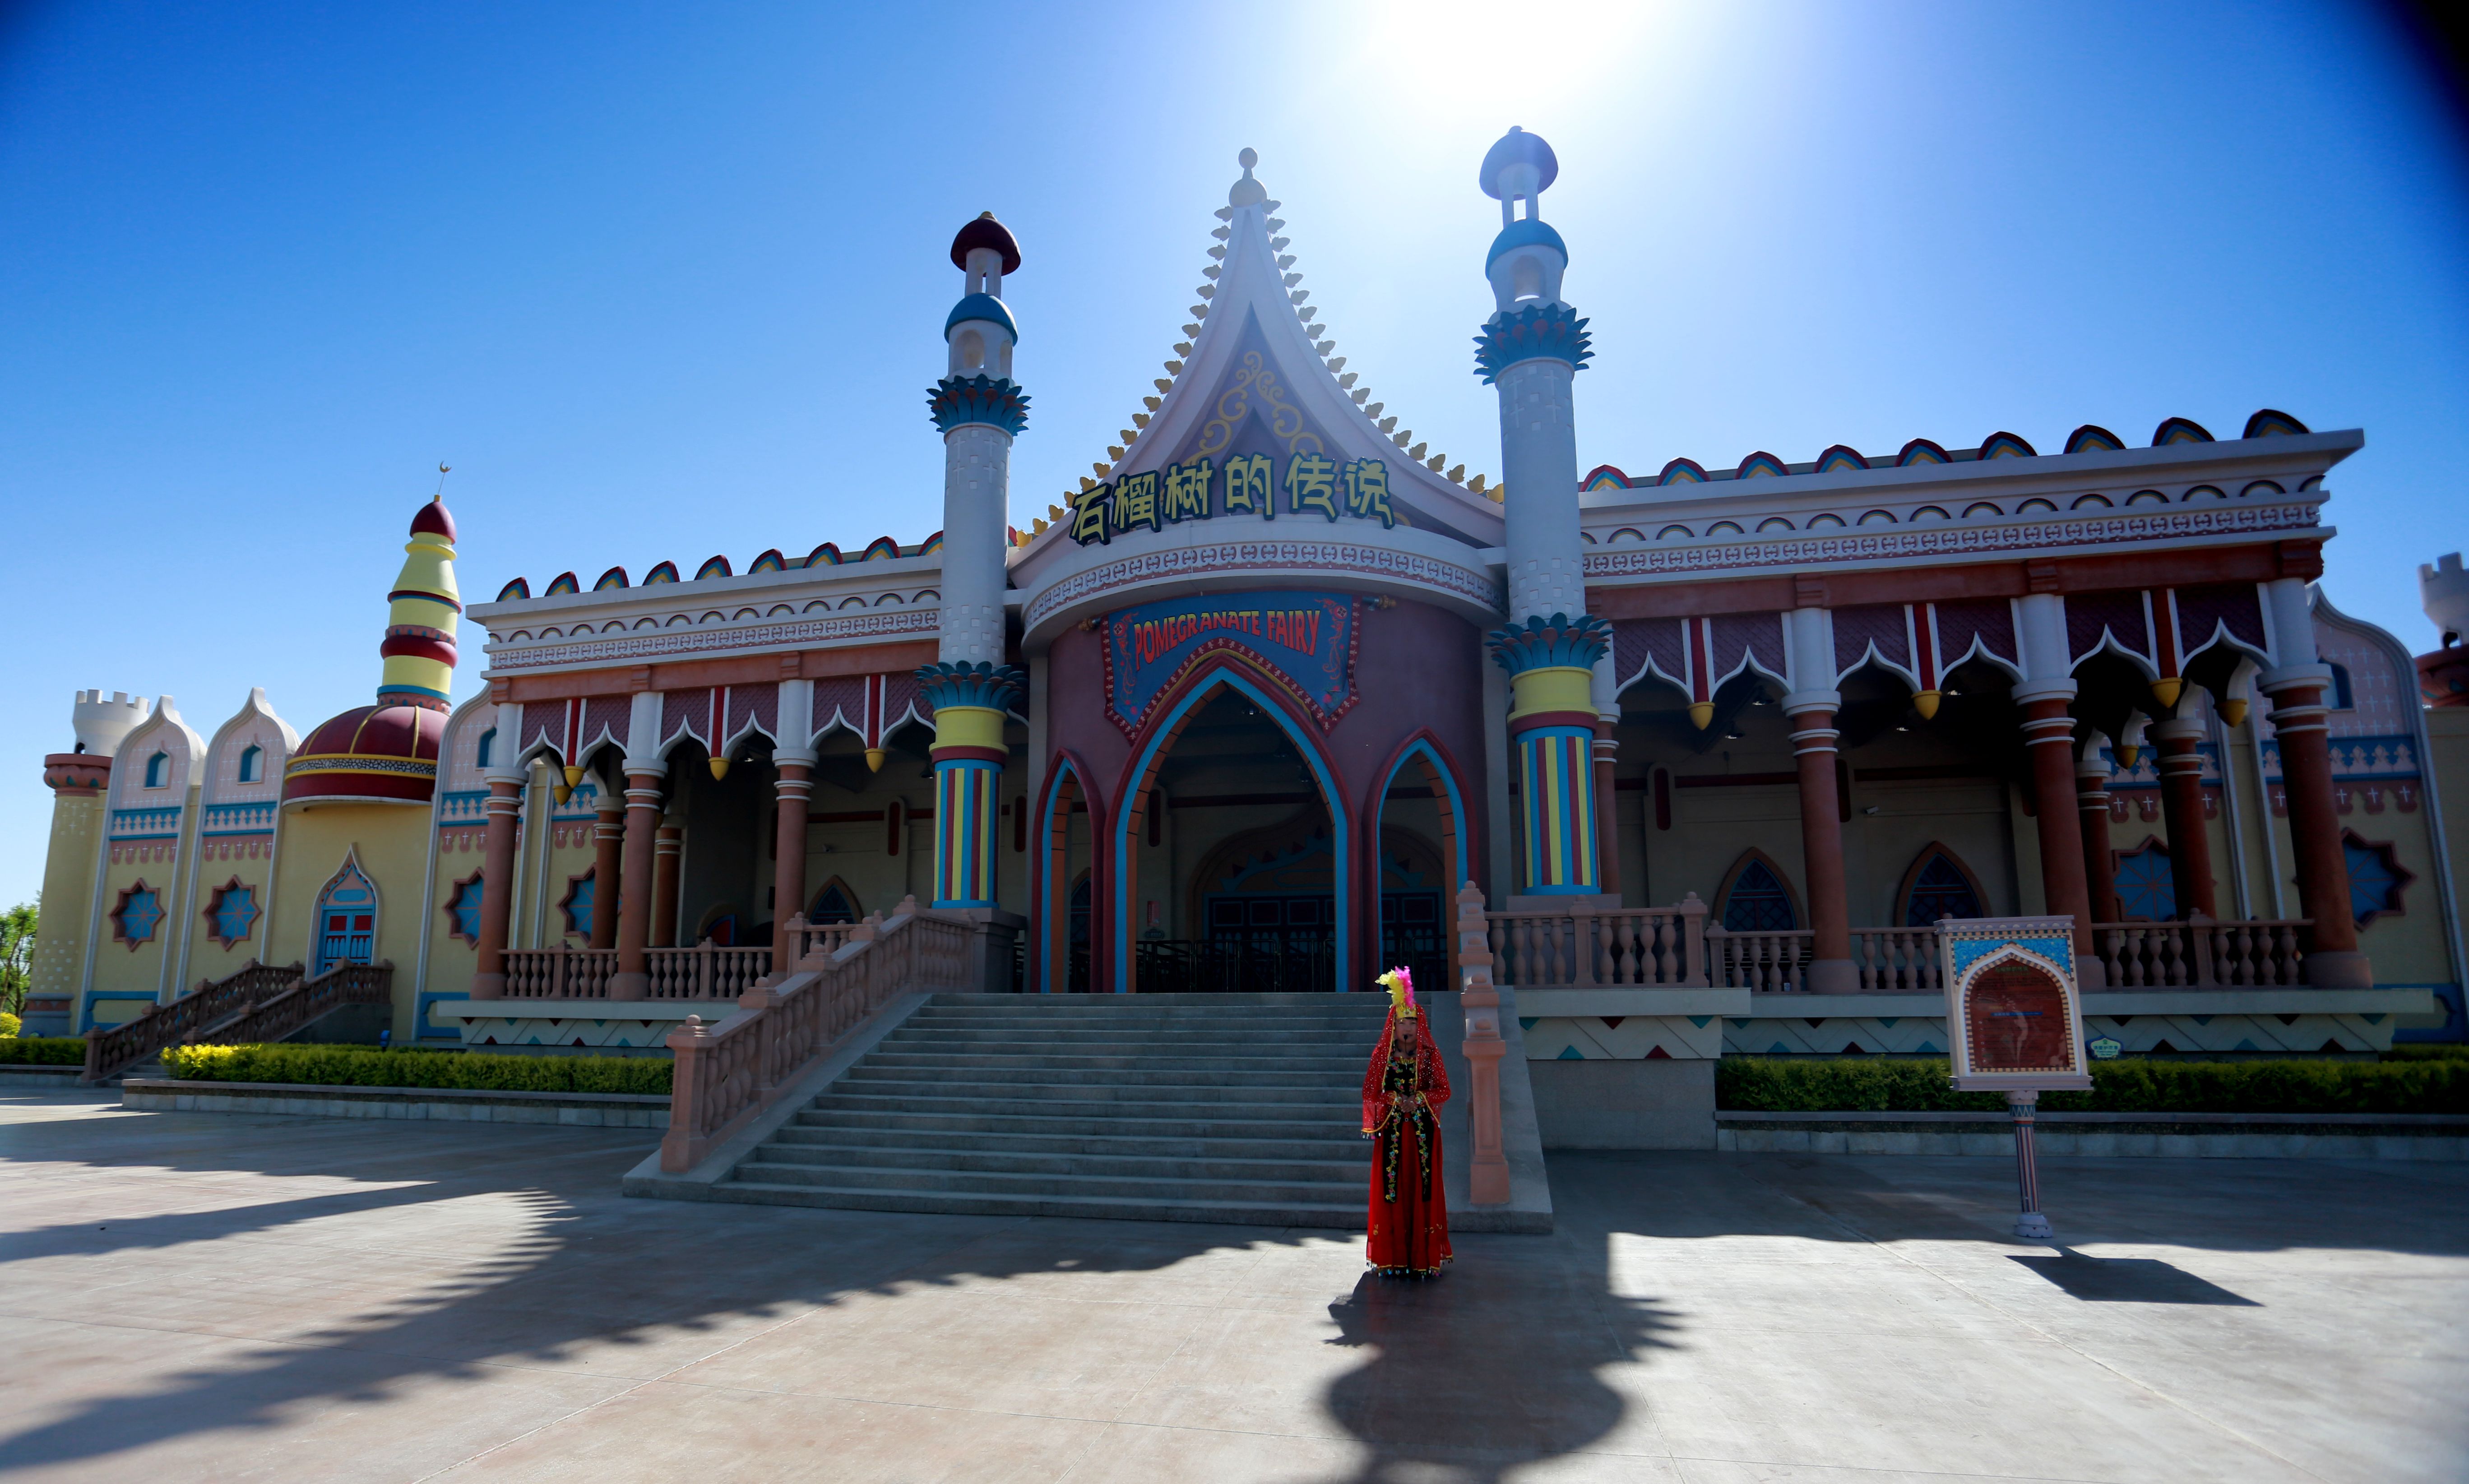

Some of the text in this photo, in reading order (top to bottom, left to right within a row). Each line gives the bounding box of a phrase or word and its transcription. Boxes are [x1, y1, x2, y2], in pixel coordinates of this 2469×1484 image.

[1070, 452, 1395, 546] 石榴树的传说
[1134, 610, 1320, 671] POMEGRANATE FAIRY
